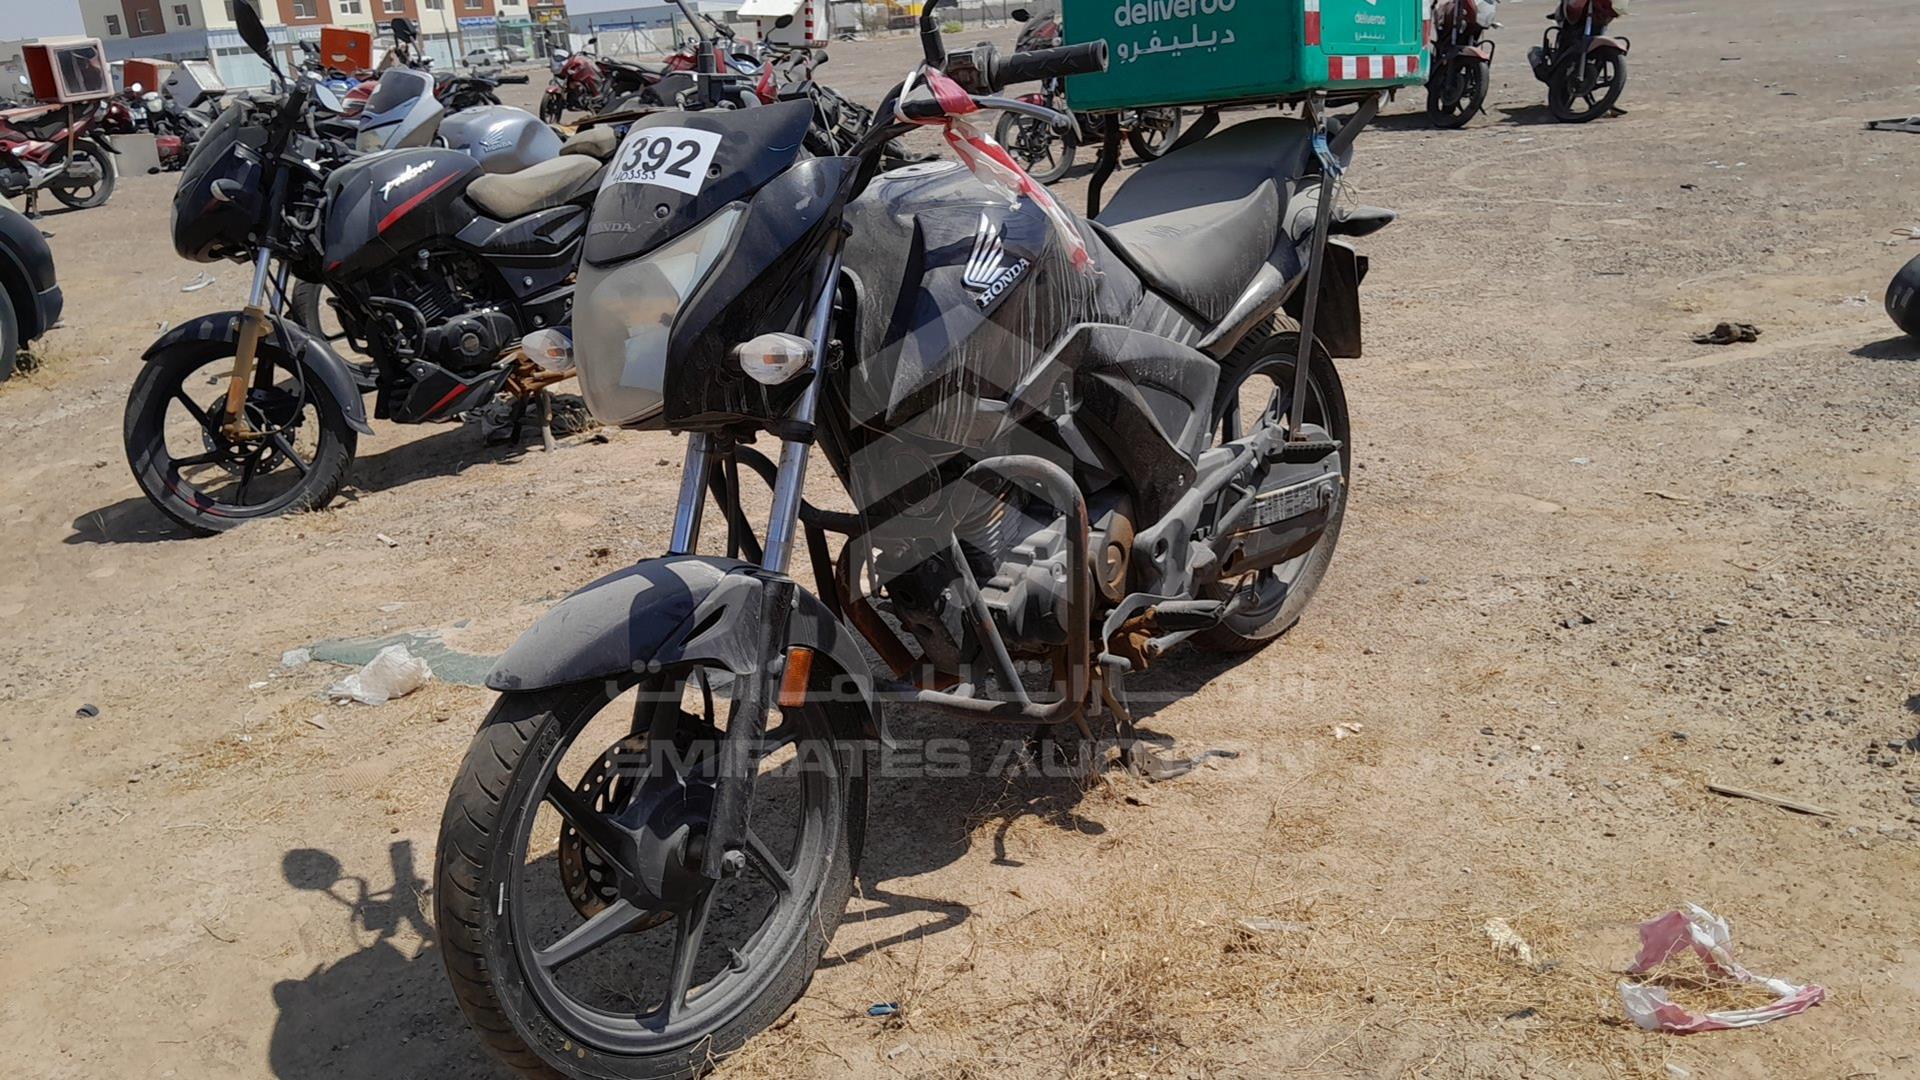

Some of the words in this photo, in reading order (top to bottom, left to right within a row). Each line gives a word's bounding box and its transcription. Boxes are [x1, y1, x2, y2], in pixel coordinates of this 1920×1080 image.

[1114, 0, 1236, 27] deliveroo
[1117, 24, 1235, 64] ديليفرو
[980, 257, 1031, 307] HONDA
